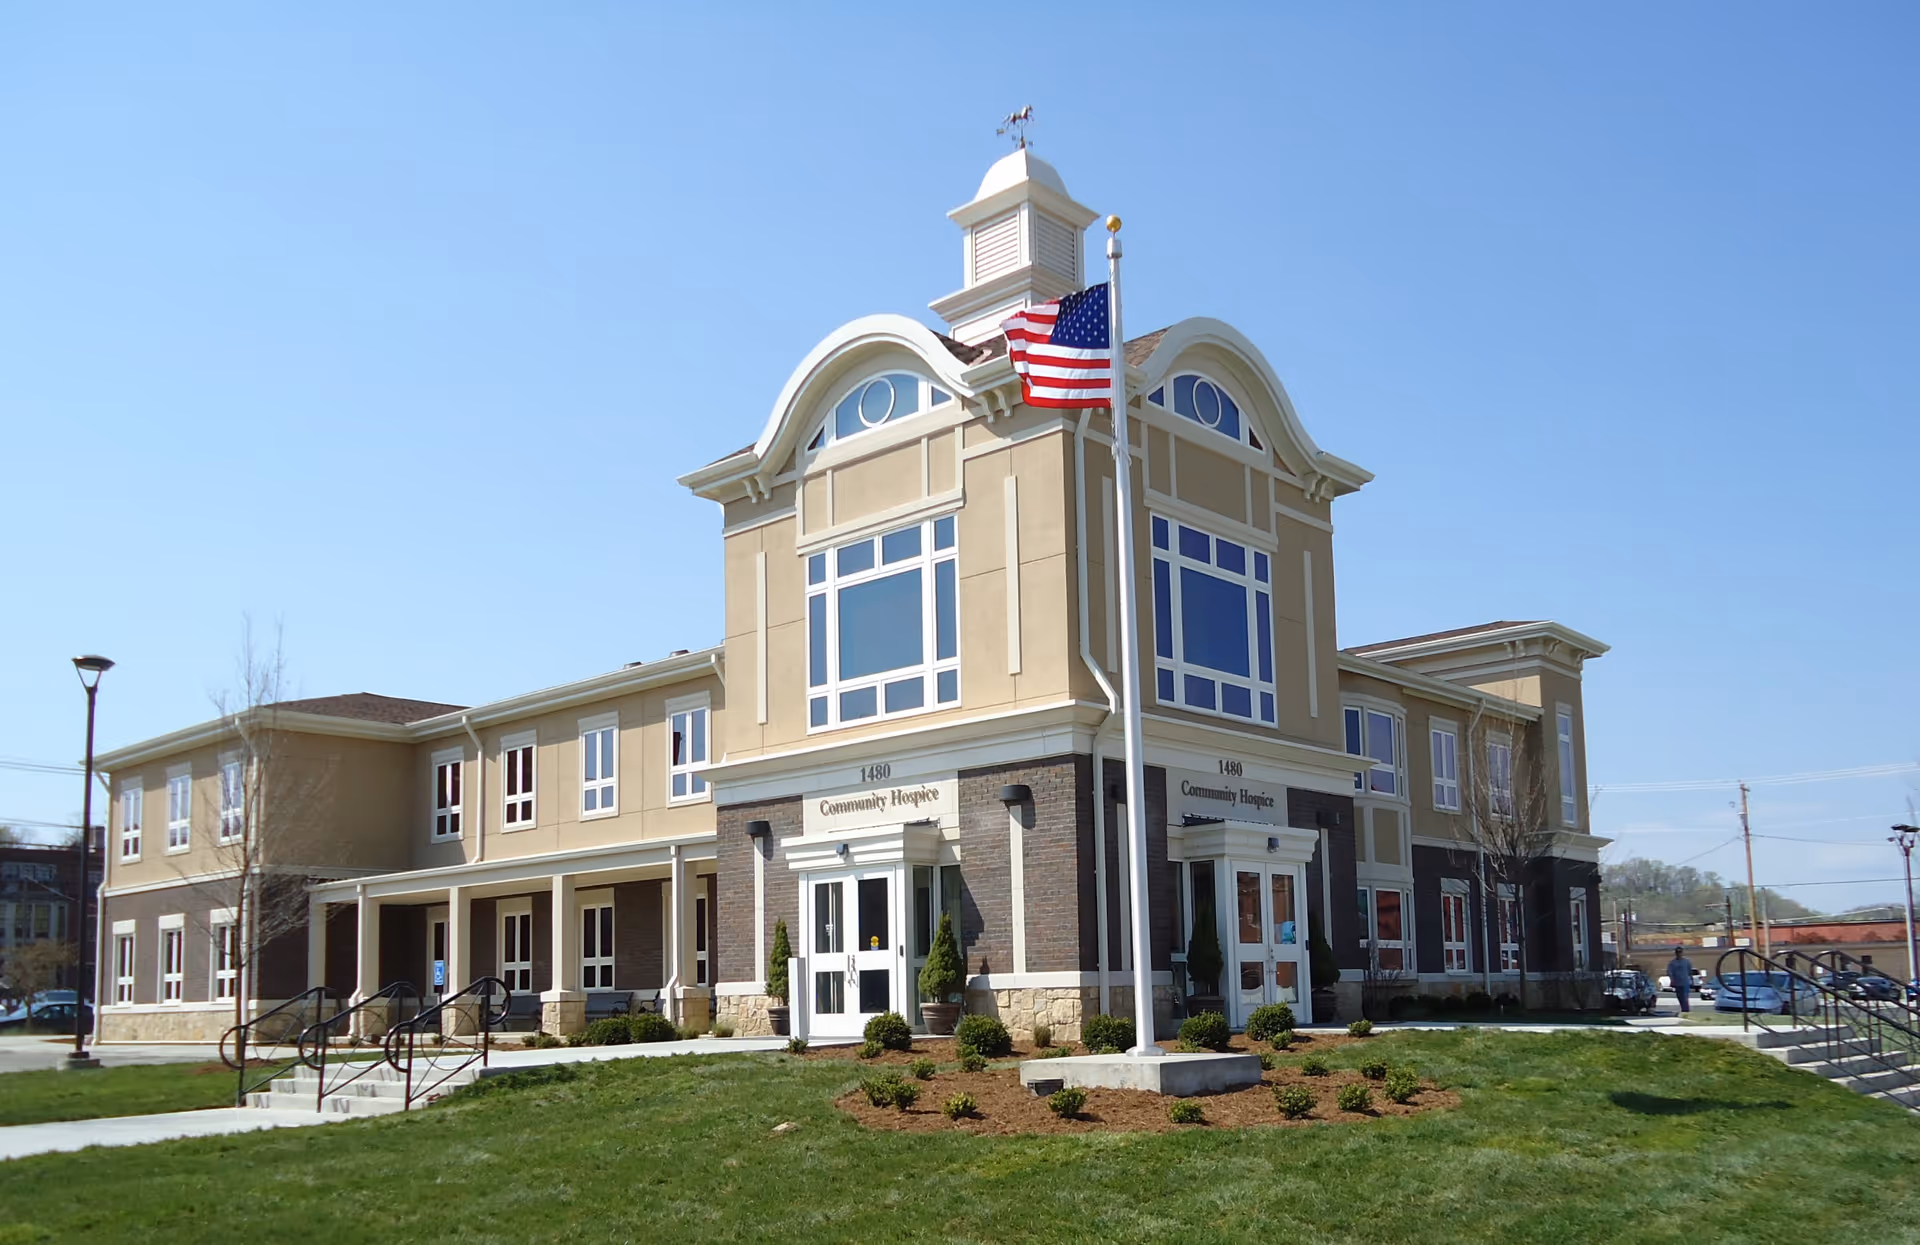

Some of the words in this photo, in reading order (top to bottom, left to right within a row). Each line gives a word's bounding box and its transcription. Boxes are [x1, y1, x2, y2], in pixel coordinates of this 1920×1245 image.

[860, 763, 891, 782] 1480
[1218, 759, 1243, 777] 1480
[819, 792, 888, 816] Community
[890, 785, 940, 808] Hospice
[1181, 780, 1237, 807] Community
[1240, 788, 1275, 810] Hospice
